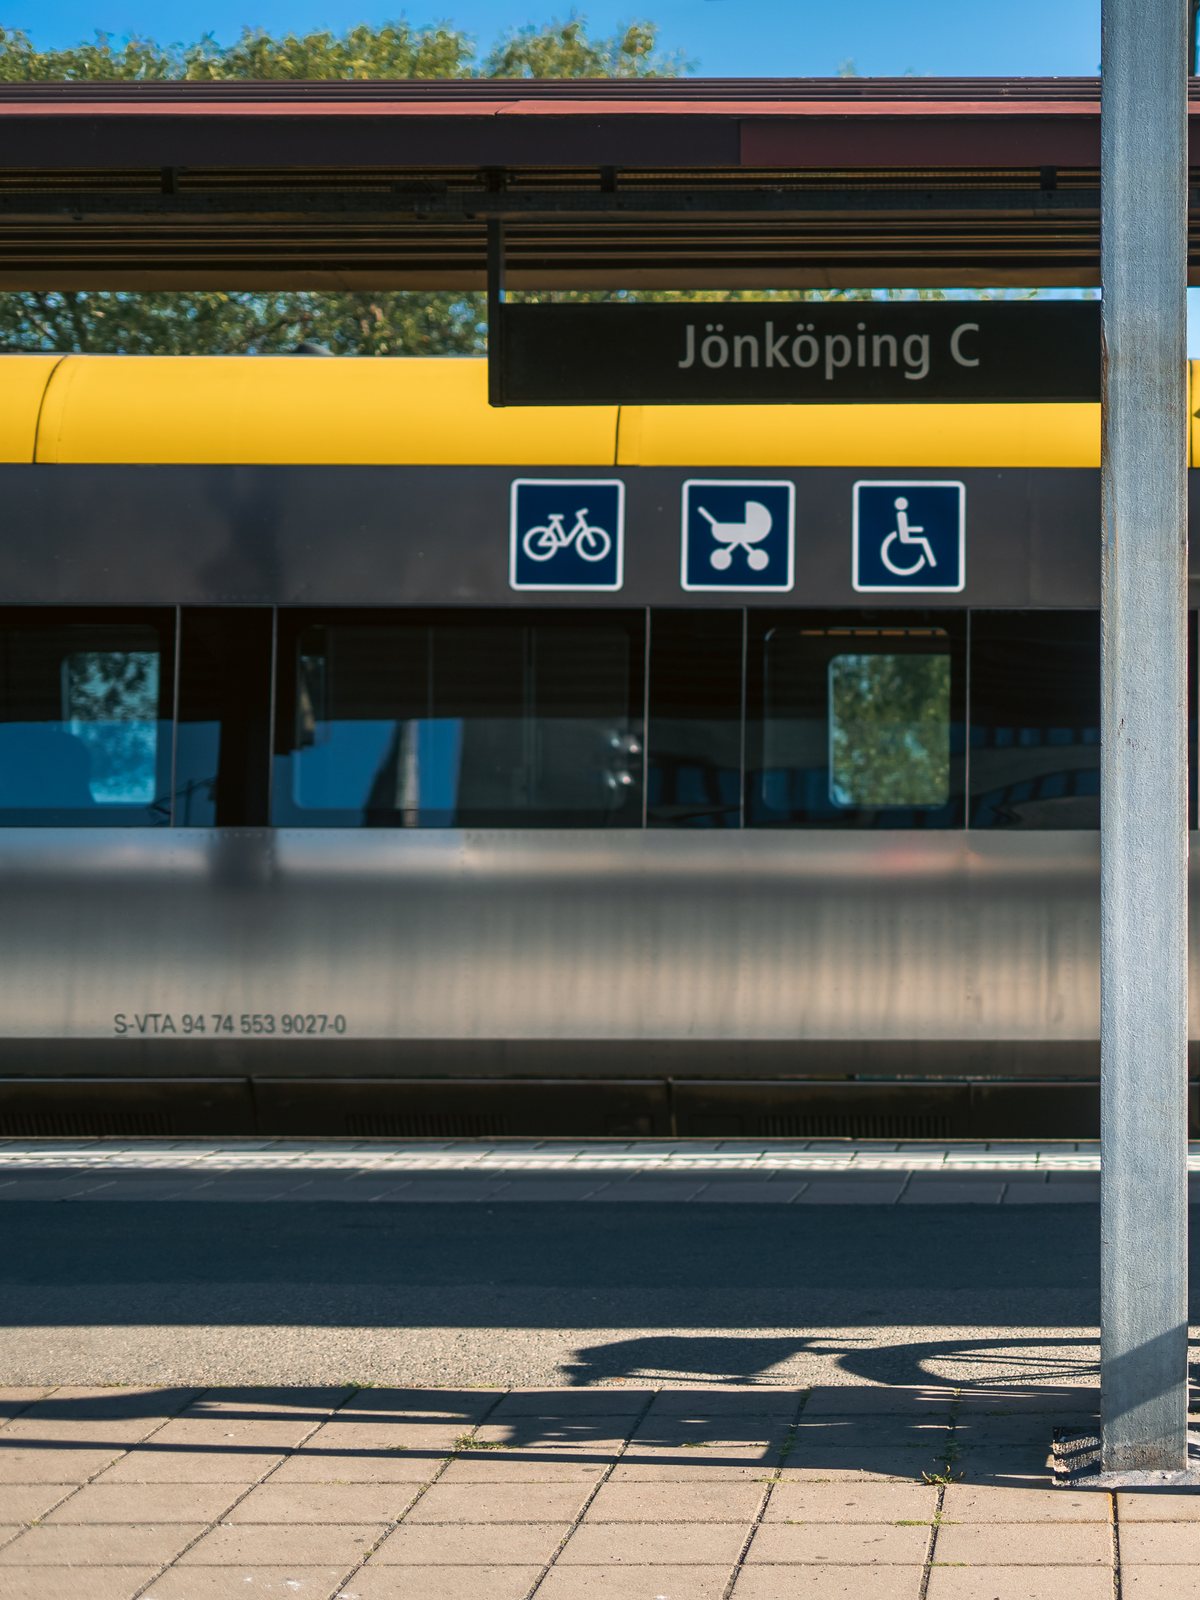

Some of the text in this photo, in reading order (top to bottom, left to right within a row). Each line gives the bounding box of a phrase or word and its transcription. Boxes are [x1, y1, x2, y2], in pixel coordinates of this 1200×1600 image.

[678, 321, 980, 380] Jönköping C
[114, 1013, 347, 1036] S-VTA 94 74 553 9027-0
